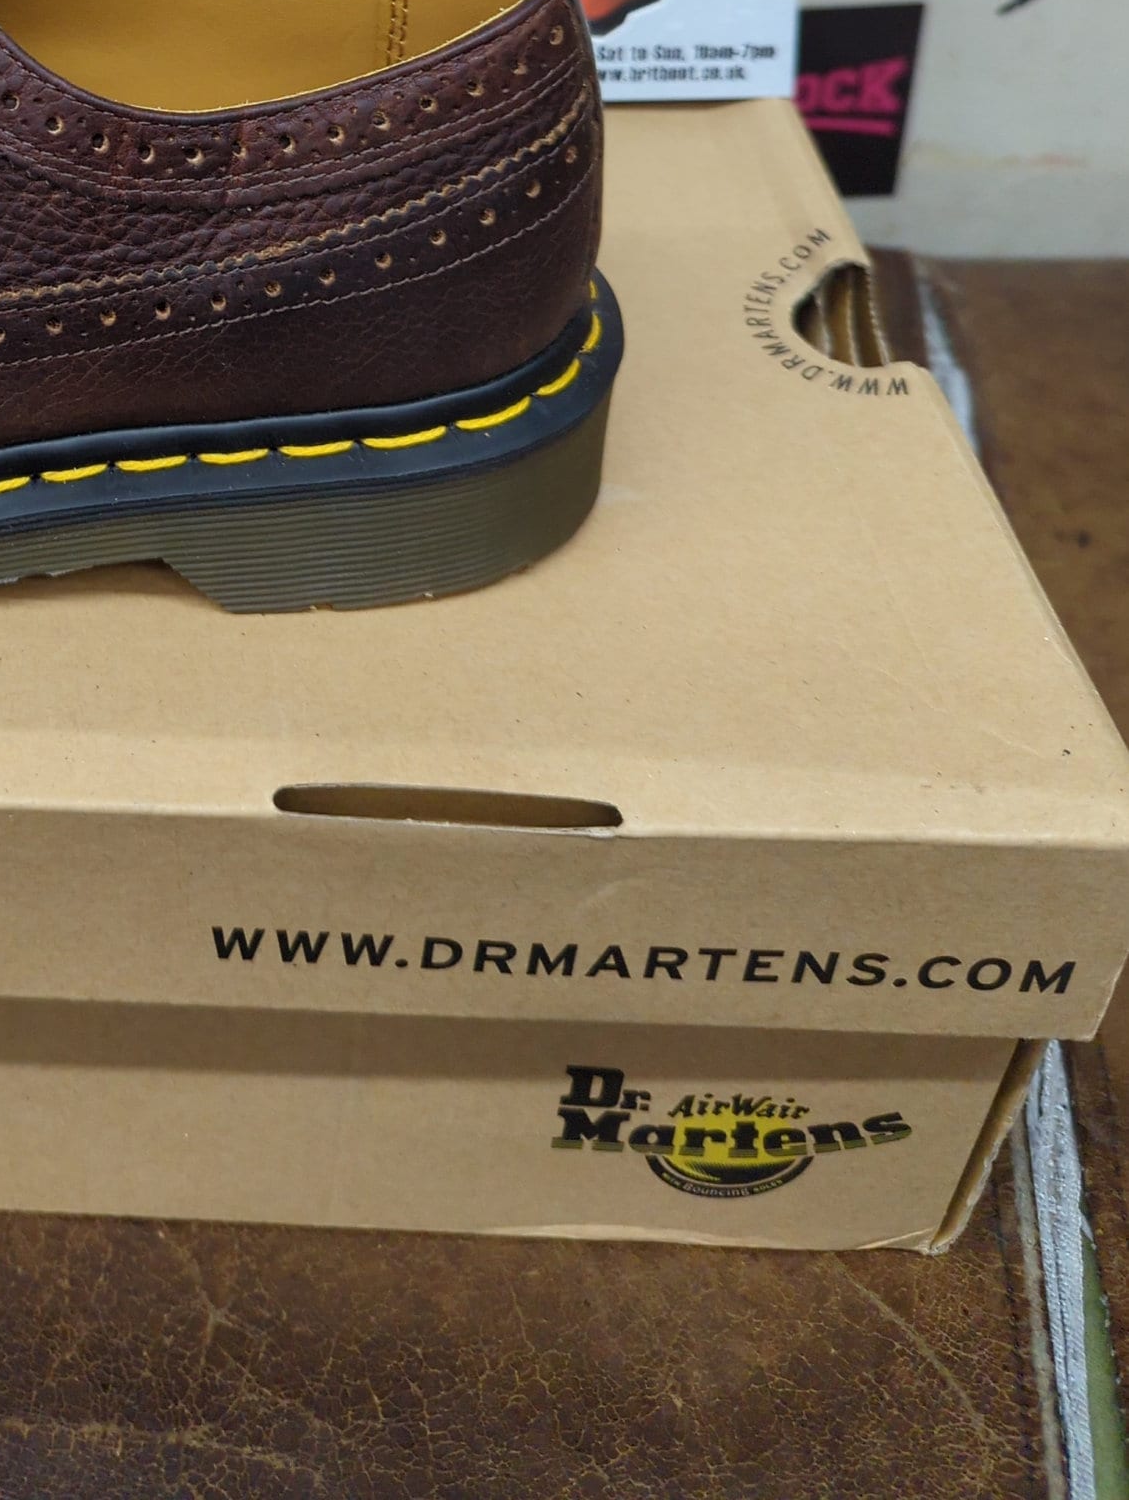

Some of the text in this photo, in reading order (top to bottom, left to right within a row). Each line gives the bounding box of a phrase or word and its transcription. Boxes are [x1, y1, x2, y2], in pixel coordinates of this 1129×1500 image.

[743, 228, 910, 396] WWW.DRMARTENS.COM
[211, 924, 1077, 996] WWW.DRMARTENS.COM
[560, 1064, 651, 1111] Dr.
[668, 1092, 810, 1120] AirWair
[551, 1106, 912, 1158] Martens
[681, 1182, 751, 1198] Bouncing
